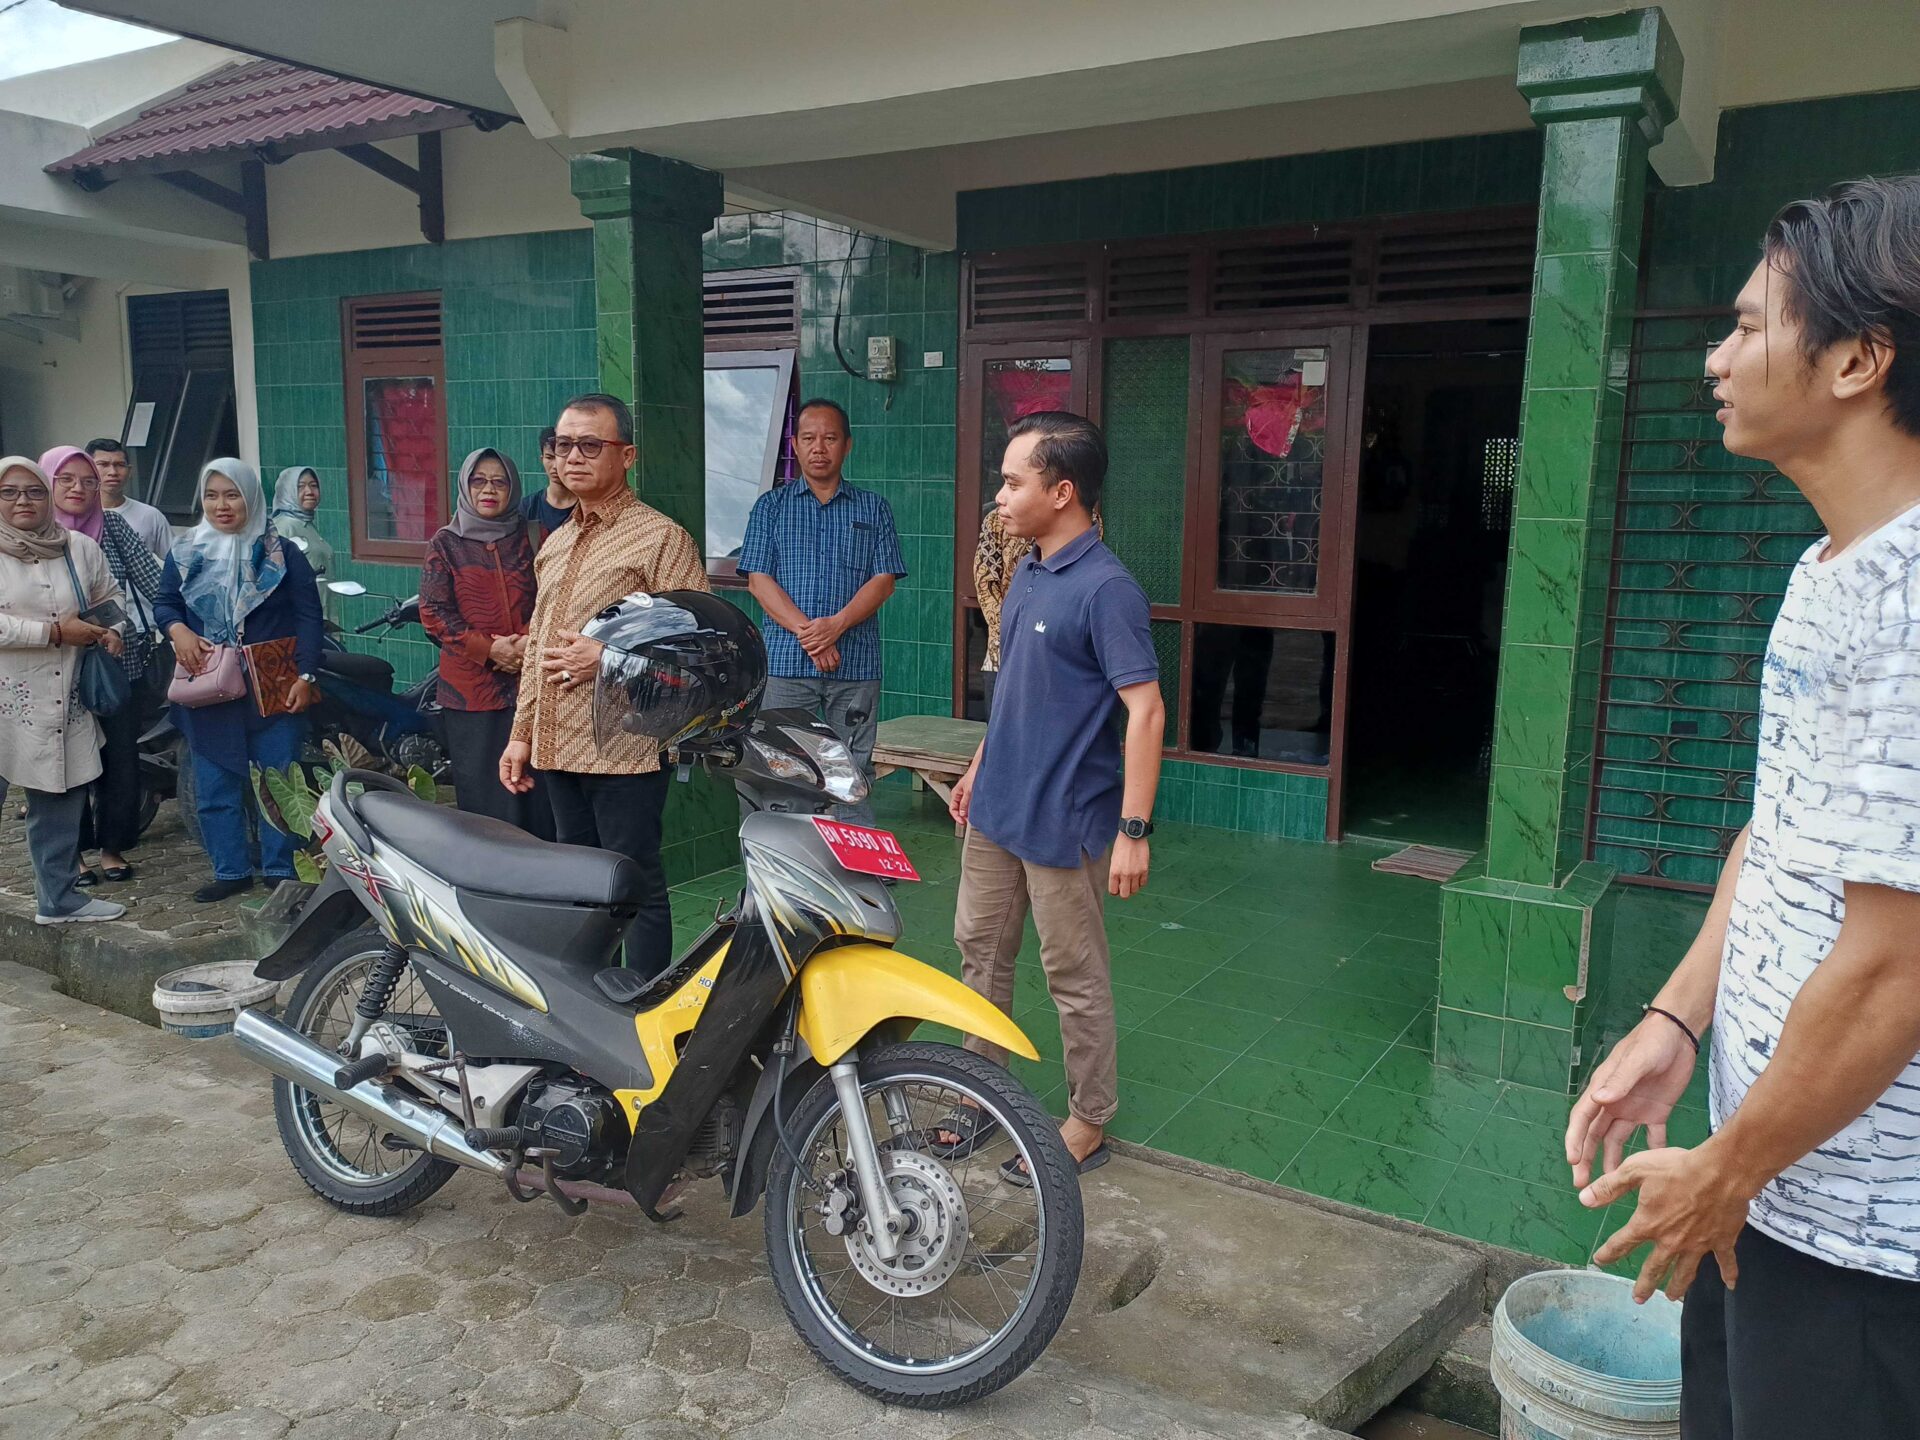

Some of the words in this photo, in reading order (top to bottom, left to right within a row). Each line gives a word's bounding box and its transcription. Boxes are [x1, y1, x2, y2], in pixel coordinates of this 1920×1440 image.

[819, 824, 844, 846] BN
[840, 828, 879, 851] 5690
[698, 976, 714, 988] HO
[449, 984, 482, 1005] COMPACT
[482, 1003, 524, 1029] COMMUTER
[545, 1129, 582, 1146] HONDA
